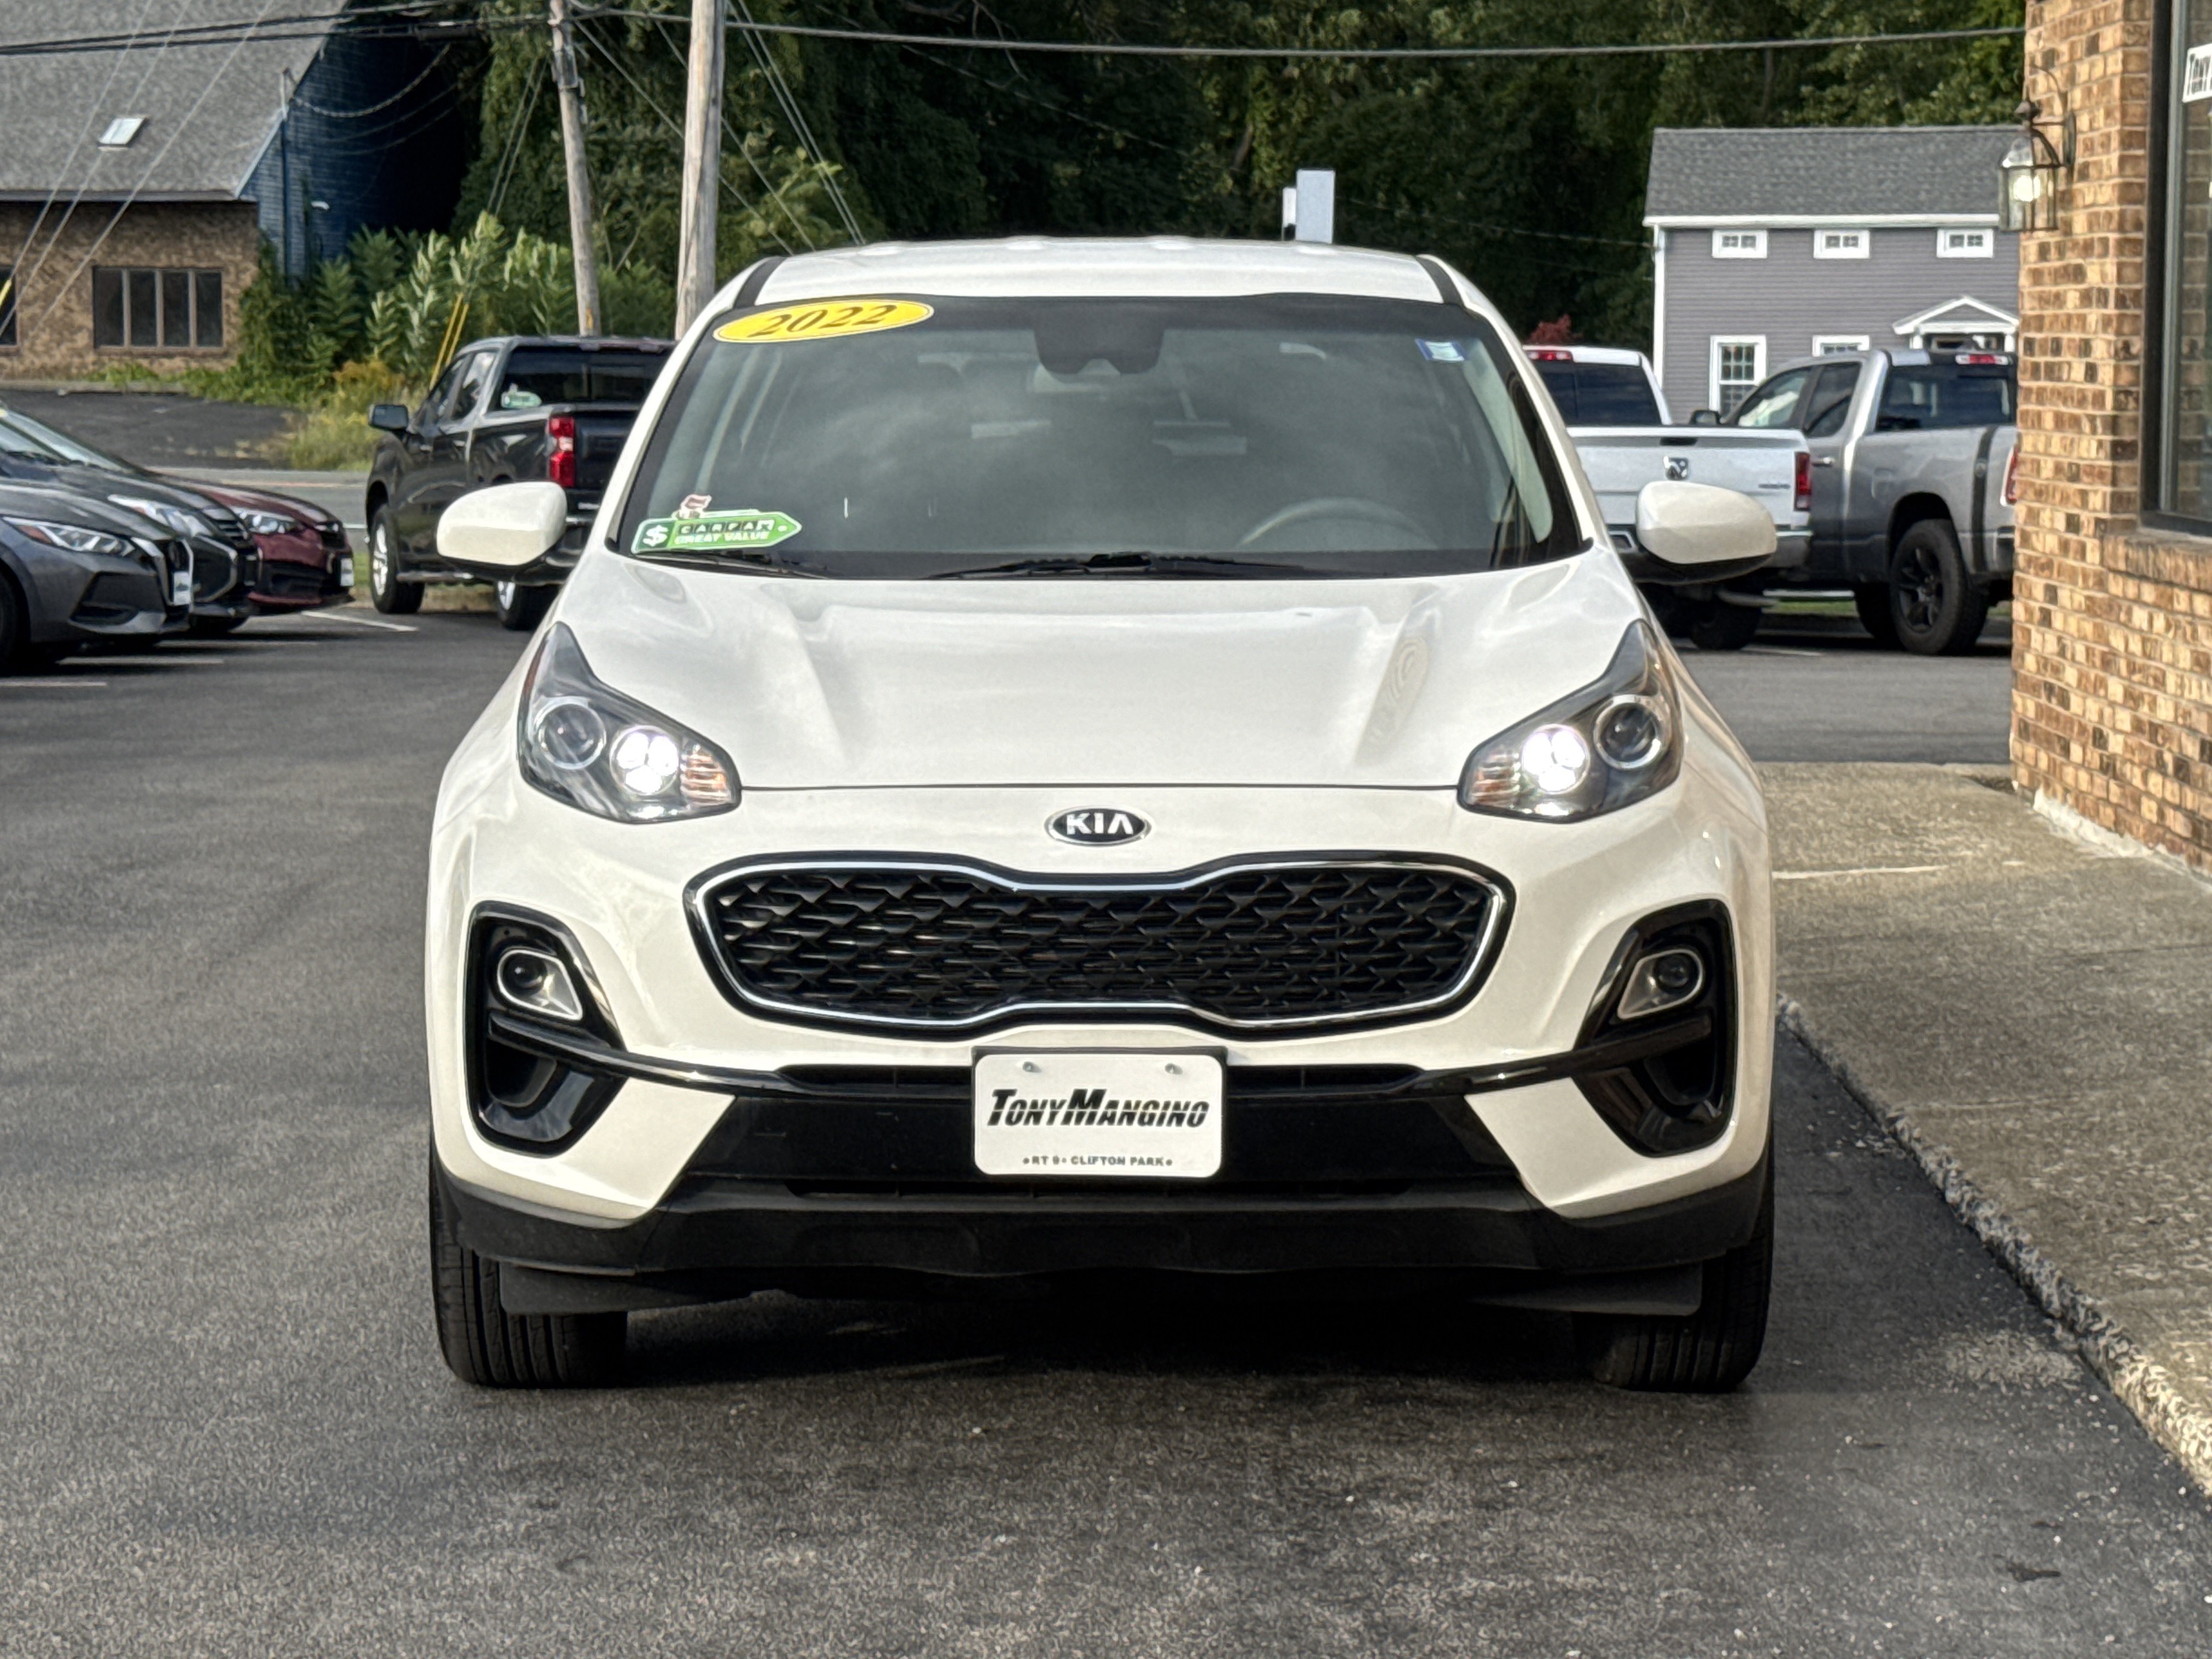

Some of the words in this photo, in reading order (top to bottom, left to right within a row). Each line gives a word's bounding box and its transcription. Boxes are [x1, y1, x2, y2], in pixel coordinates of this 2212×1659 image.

[747, 304, 898, 338] 2022
[680, 521, 773, 534] CARFAX
[674, 533, 723, 545] GREAT
[724, 531, 771, 542] VALUE
[1066, 812, 1134, 835] KIA
[1070, 1156, 1125, 1166] CLIFTON
[1130, 1156, 1164, 1167] PARK
